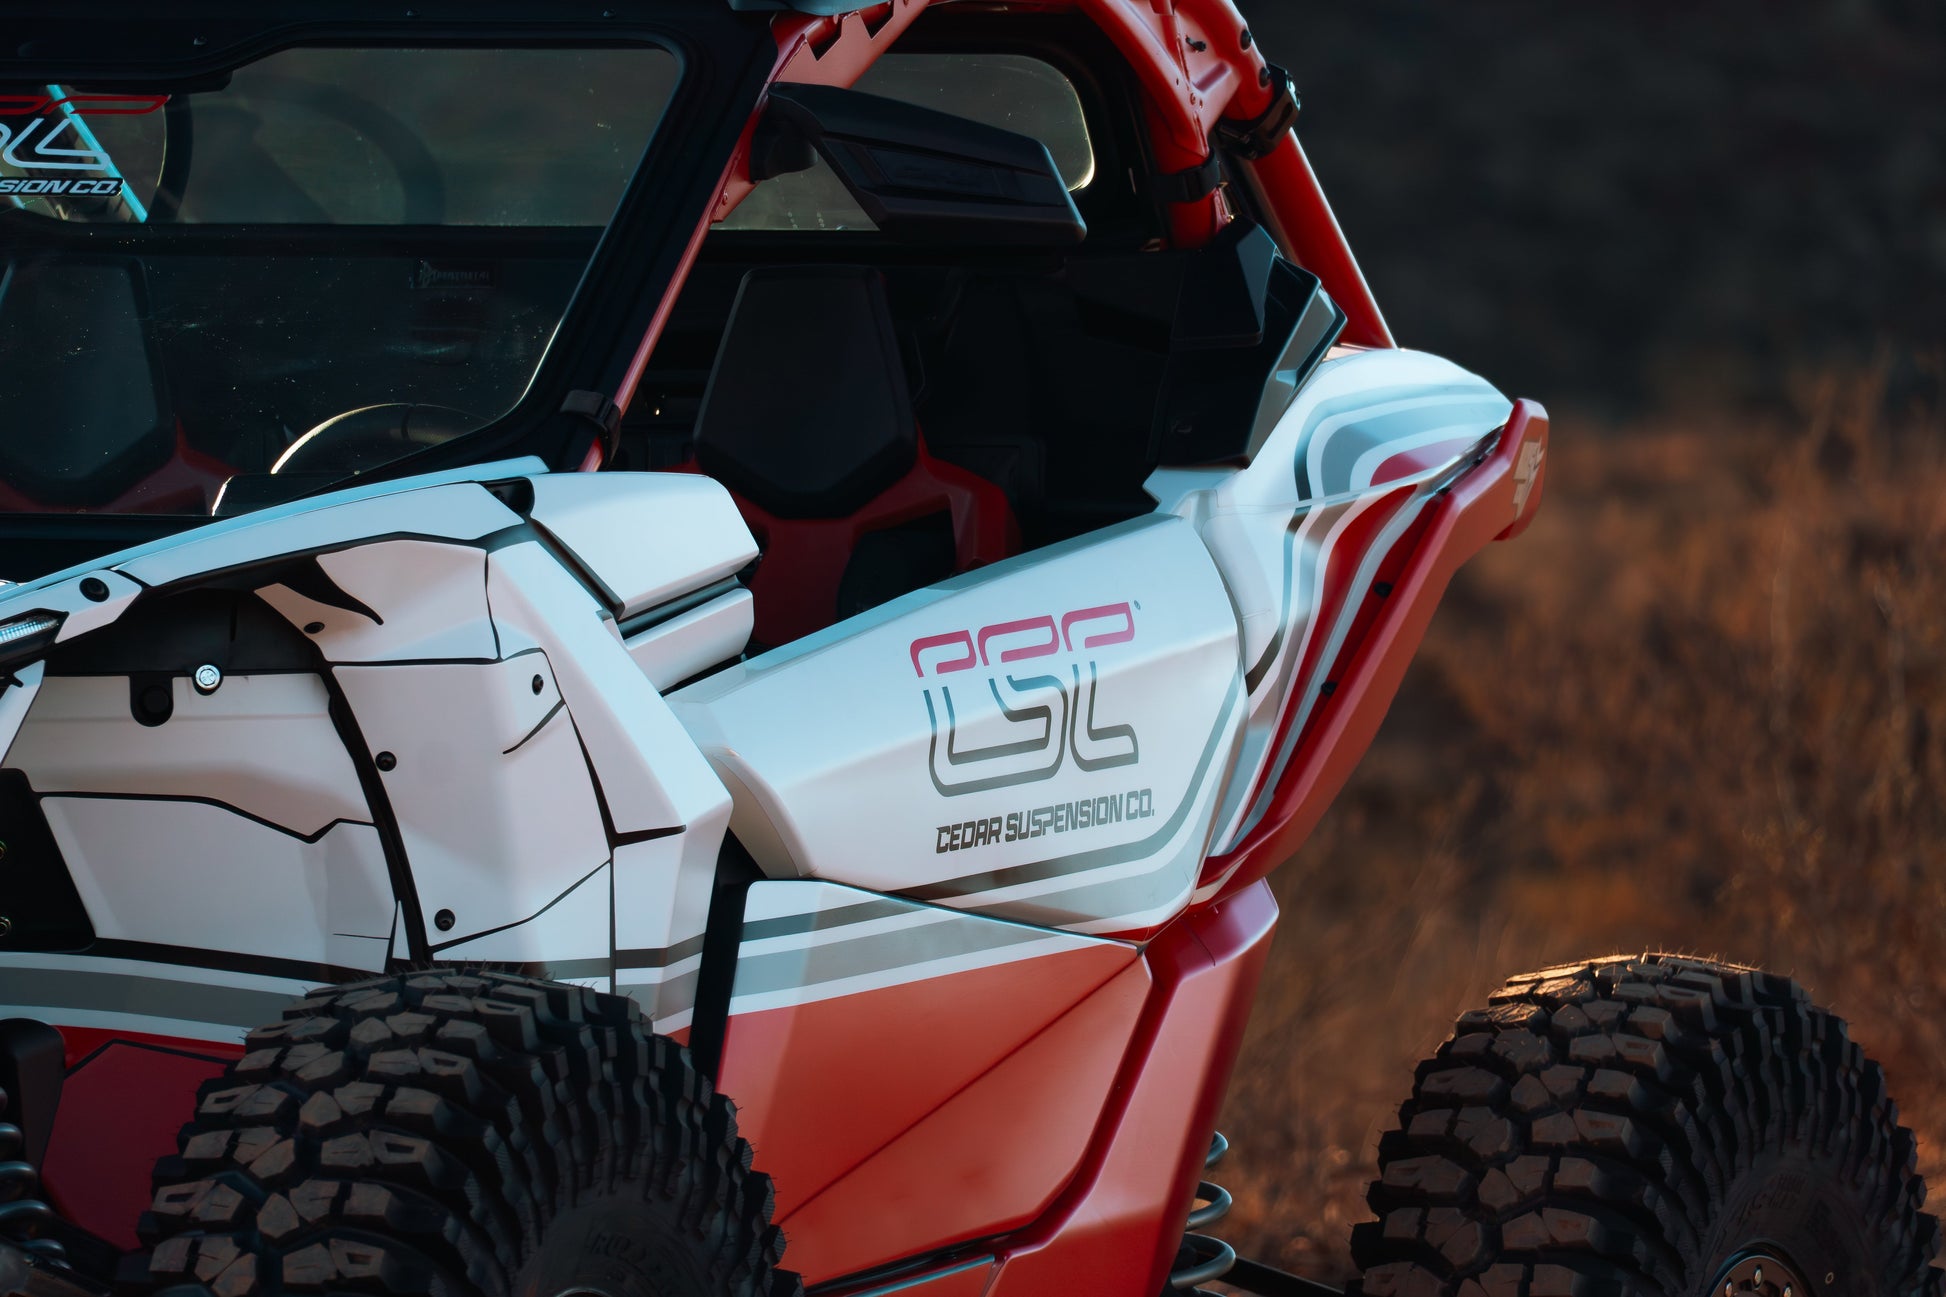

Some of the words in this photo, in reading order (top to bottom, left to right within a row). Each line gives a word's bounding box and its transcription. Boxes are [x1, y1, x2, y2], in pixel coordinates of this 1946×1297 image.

[69, 180, 118, 194] CO.
[936, 816, 1003, 854] CEDAR
[1005, 793, 1124, 842] SUSPENSION
[1125, 788, 1155, 821] CO.
